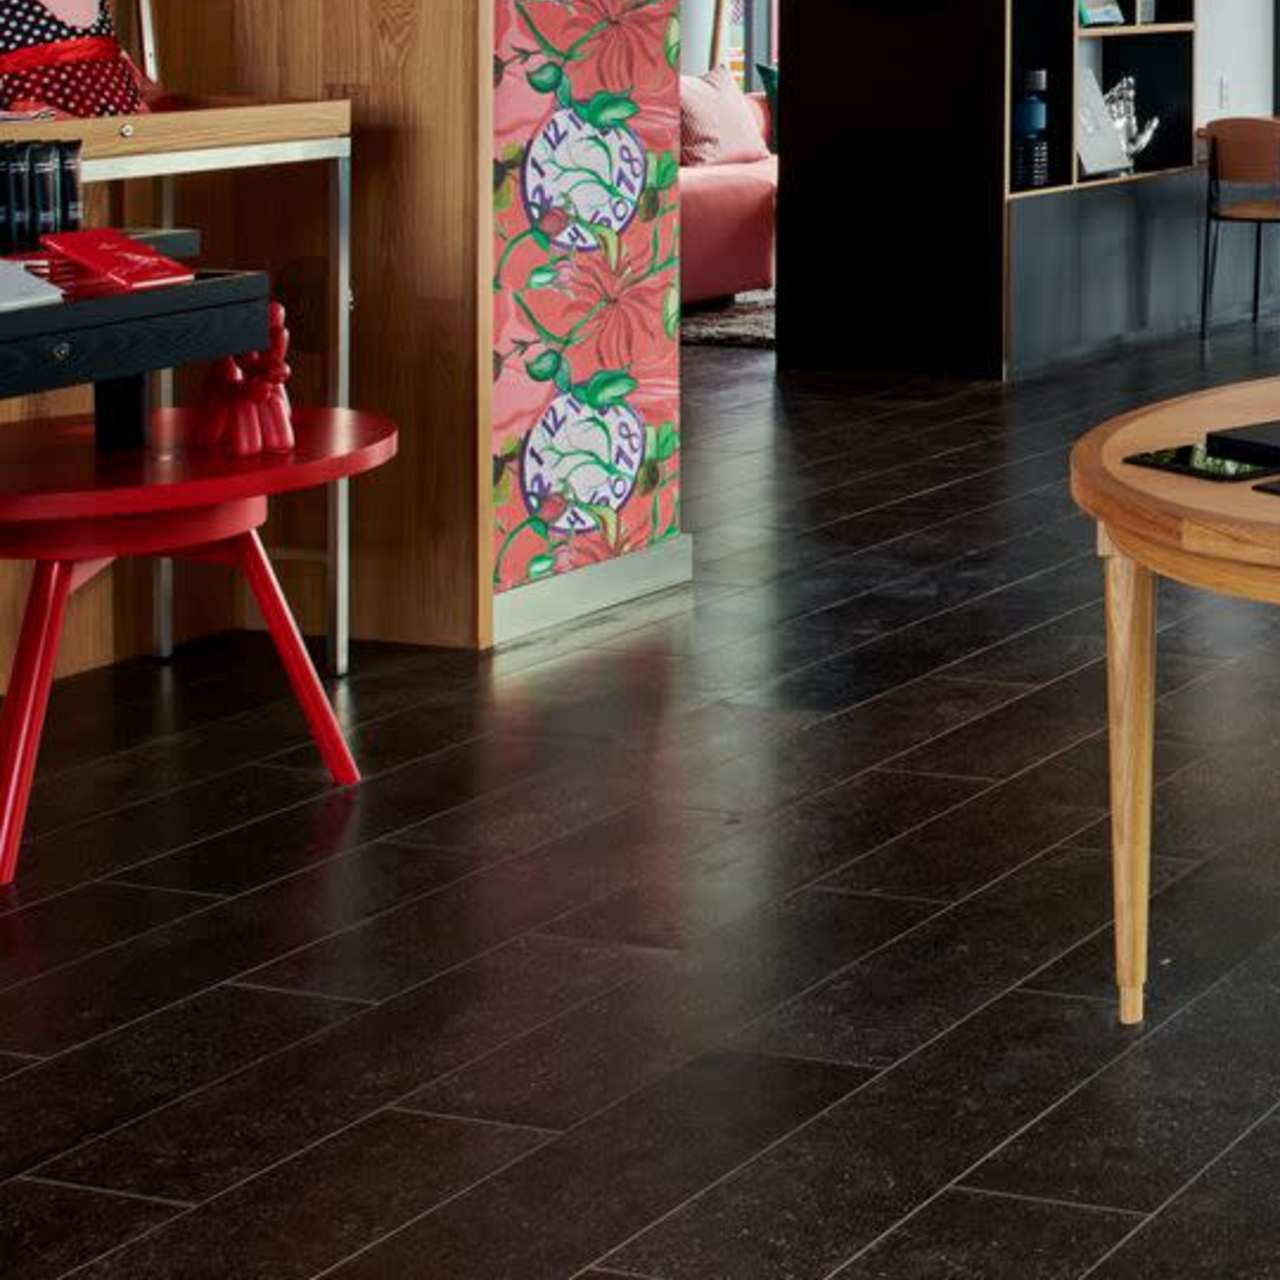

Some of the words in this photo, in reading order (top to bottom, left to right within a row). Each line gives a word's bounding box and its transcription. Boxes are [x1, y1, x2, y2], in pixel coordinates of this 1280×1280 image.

[542, 118, 569, 151] 12
[619, 144, 642, 179] 8
[616, 167, 636, 196] 7
[609, 195, 630, 222] 6
[567, 225, 588, 244] 4
[541, 404, 568, 438] 12
[618, 420, 641, 454] 8
[615, 445, 635, 470] 7
[608, 476, 627, 499] 6
[566, 507, 587, 526] 4
